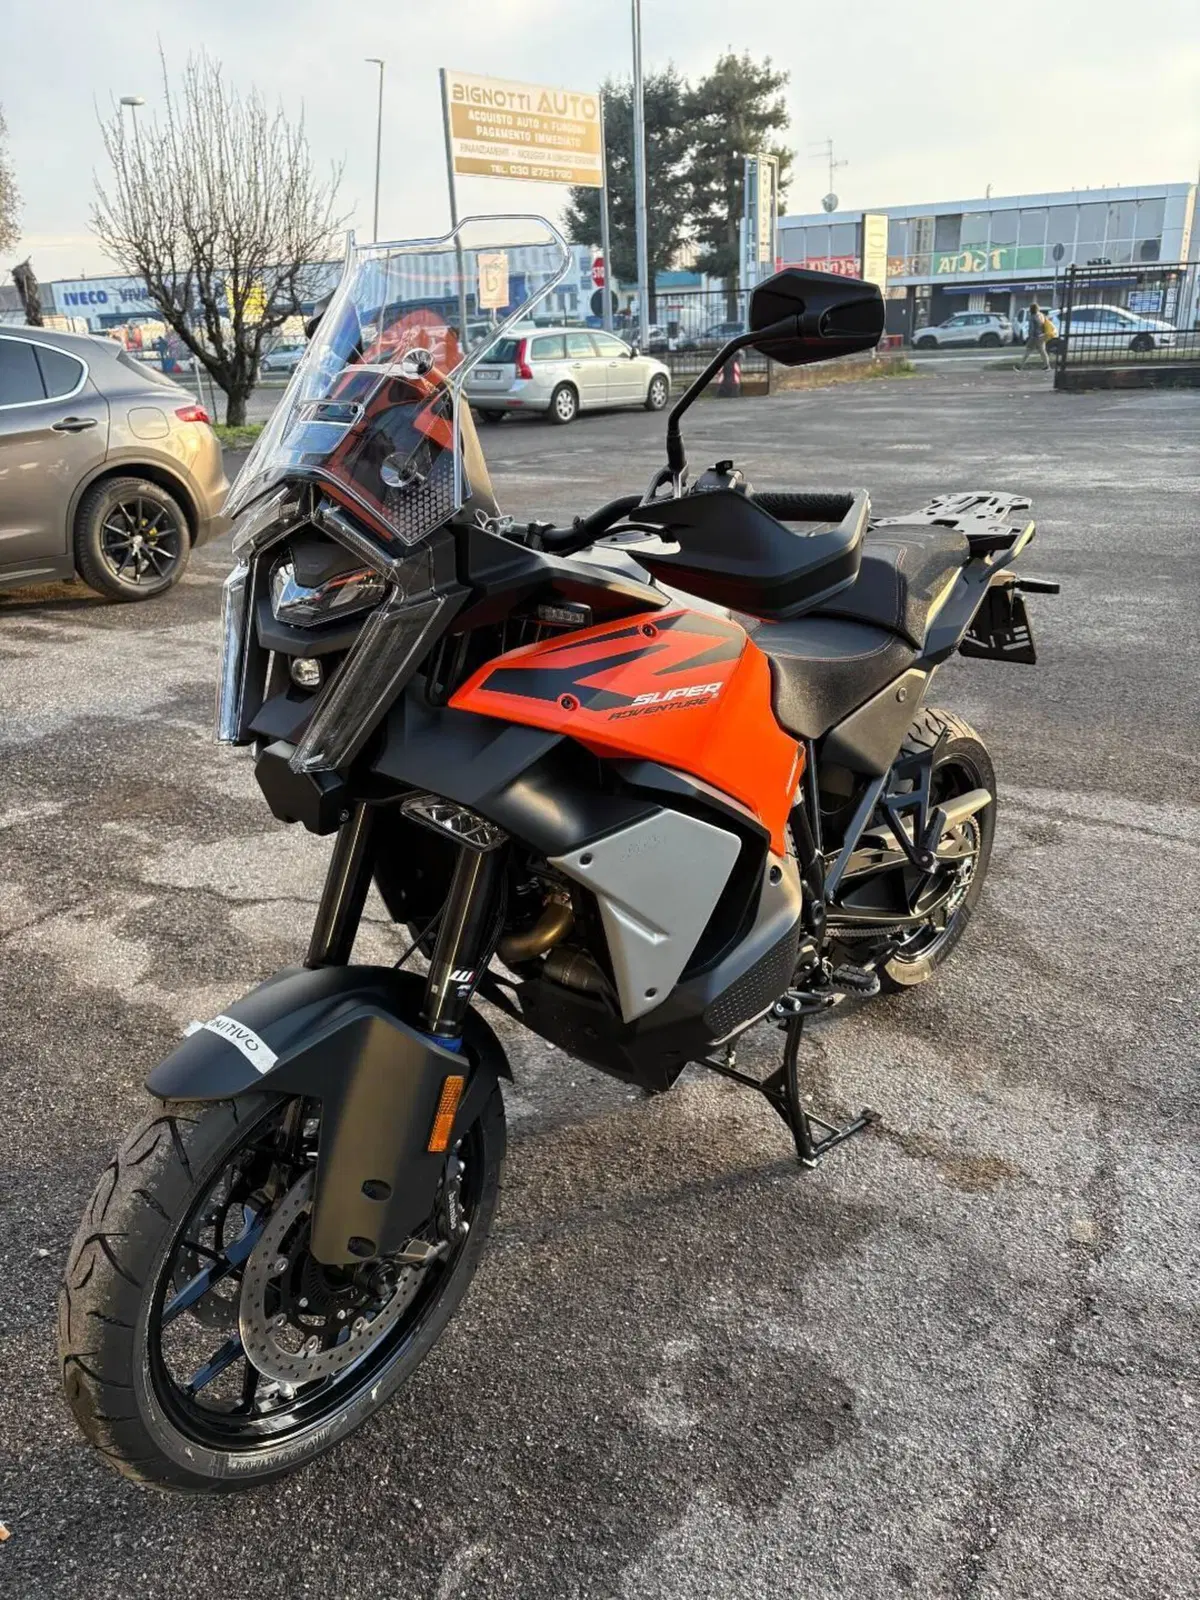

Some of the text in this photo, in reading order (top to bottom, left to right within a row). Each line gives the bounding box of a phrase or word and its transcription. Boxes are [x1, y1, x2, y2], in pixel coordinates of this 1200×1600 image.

[452, 83, 596, 119] BIGNOTTI AUTO
[468, 109, 513, 125] ACQUISTO
[517, 116, 540, 129] AUTO
[476, 125, 531, 142] PAGAMENTO
[510, 165, 529, 177] 030
[64, 290, 108, 306] IVECO
[631, 681, 724, 707] SUPER
[607, 697, 712, 721] ADVENTURE
